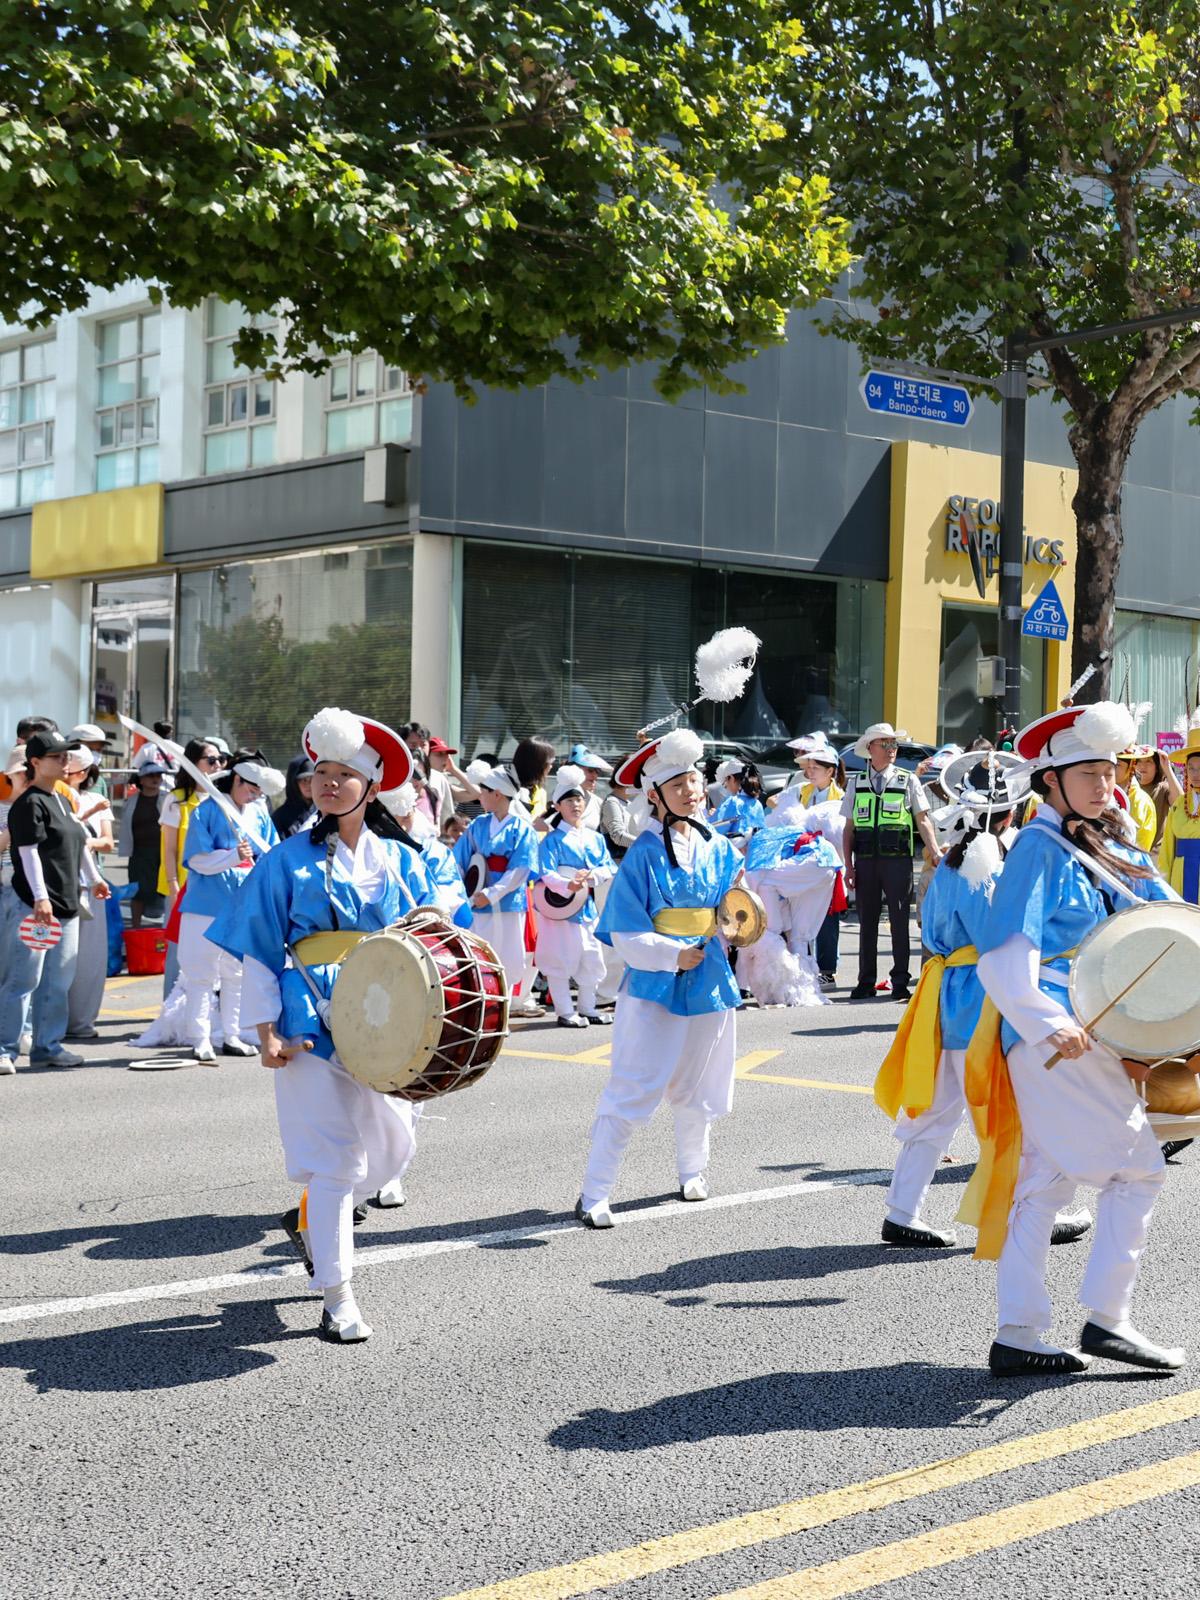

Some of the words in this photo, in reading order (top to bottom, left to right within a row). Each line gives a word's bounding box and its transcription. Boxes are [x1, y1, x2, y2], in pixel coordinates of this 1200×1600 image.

[869, 384, 882, 398] 94
[894, 380, 943, 403] 반포대로
[888, 398, 947, 419] Banpo-daero
[953, 400, 966, 413] 90
[1026, 623, 1066, 637] 자전거횡단
